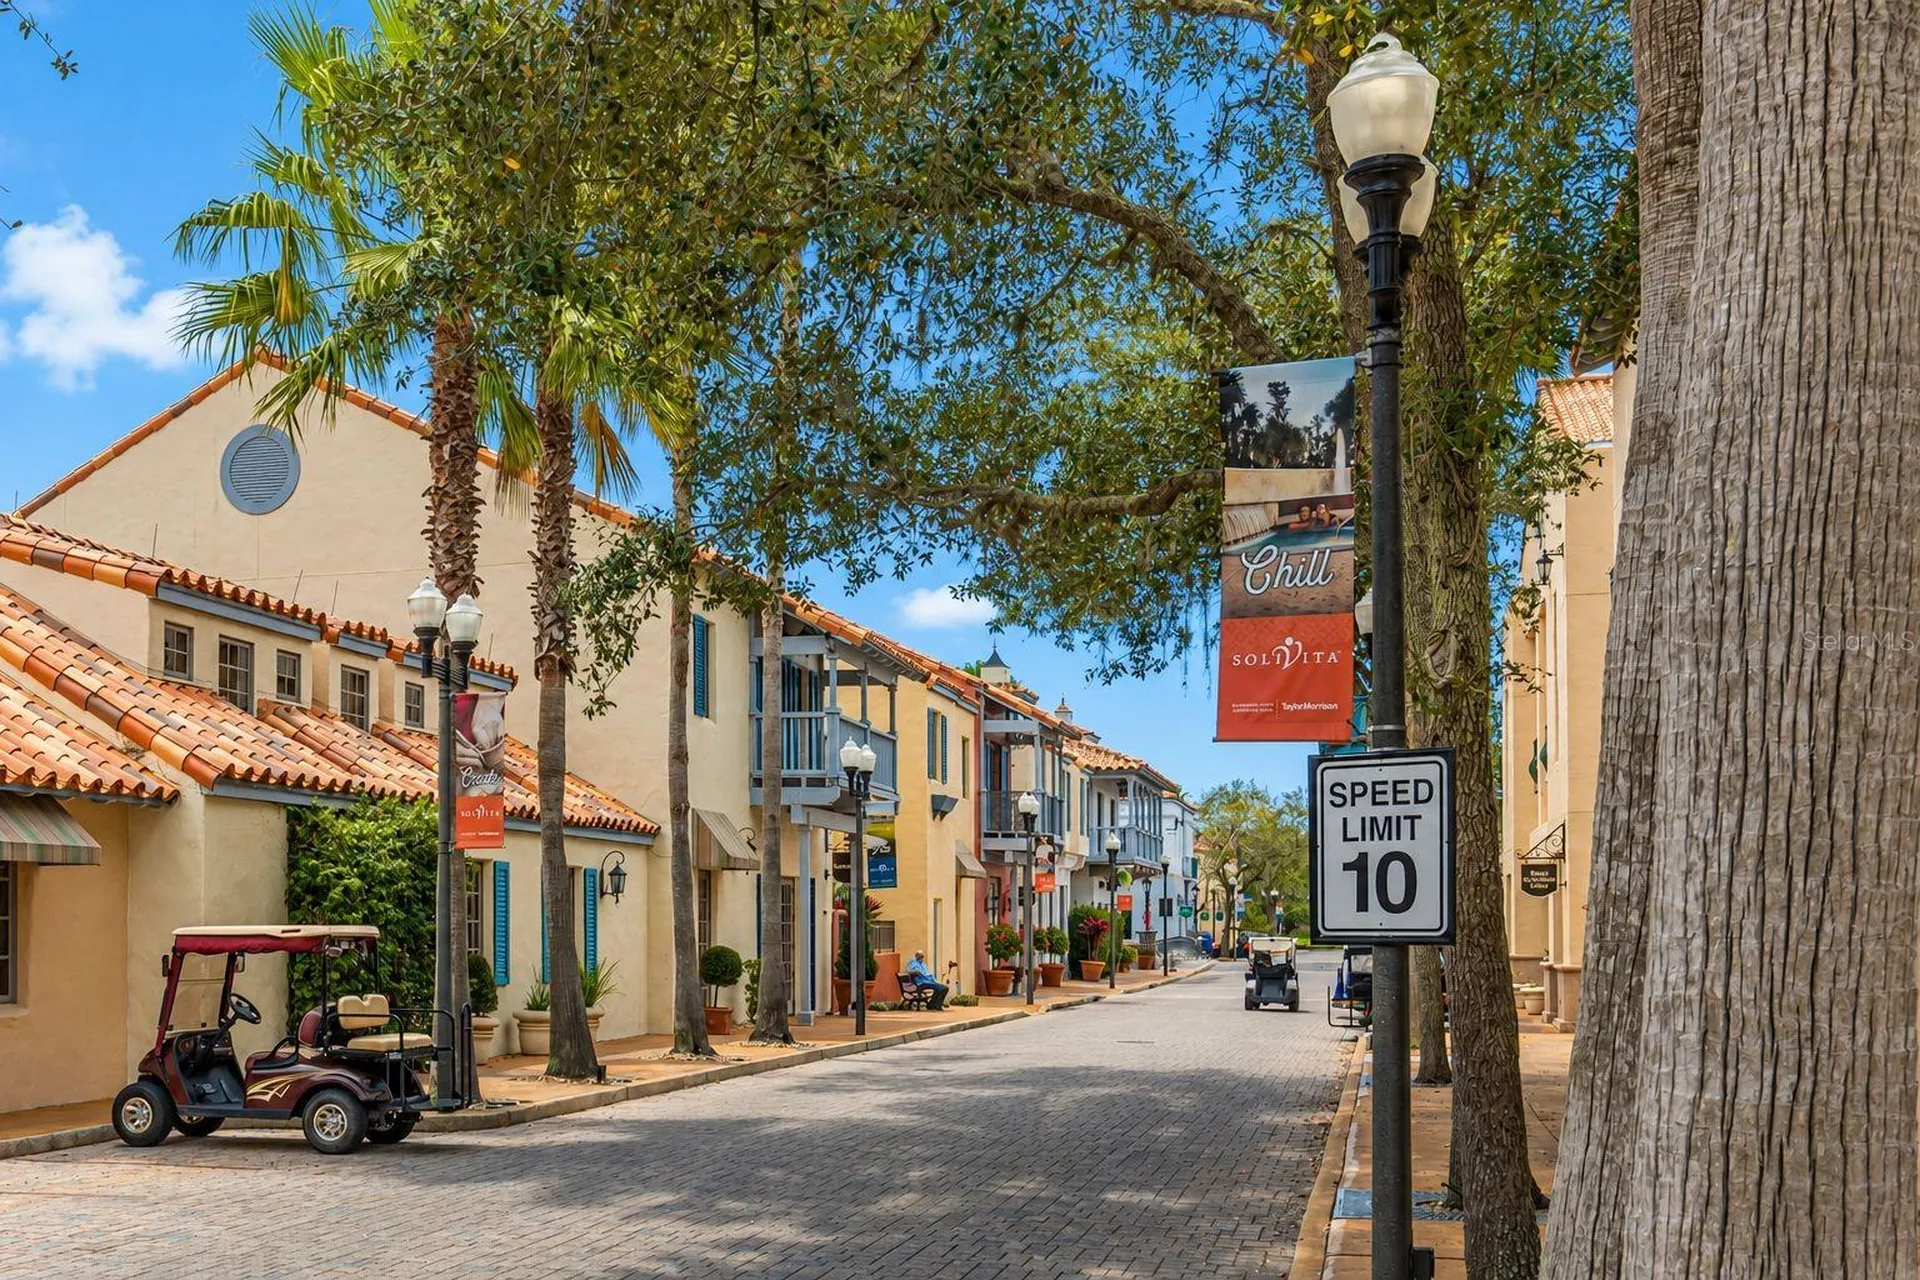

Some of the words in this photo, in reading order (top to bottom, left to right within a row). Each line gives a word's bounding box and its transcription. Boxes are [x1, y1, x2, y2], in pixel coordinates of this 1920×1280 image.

[1241, 544, 1333, 595] Chill
[1232, 637, 1339, 670] SOLIVITA
[1329, 778, 1434, 808] SPEED
[1342, 815, 1422, 842] LIMIT
[1342, 851, 1418, 914] 10
